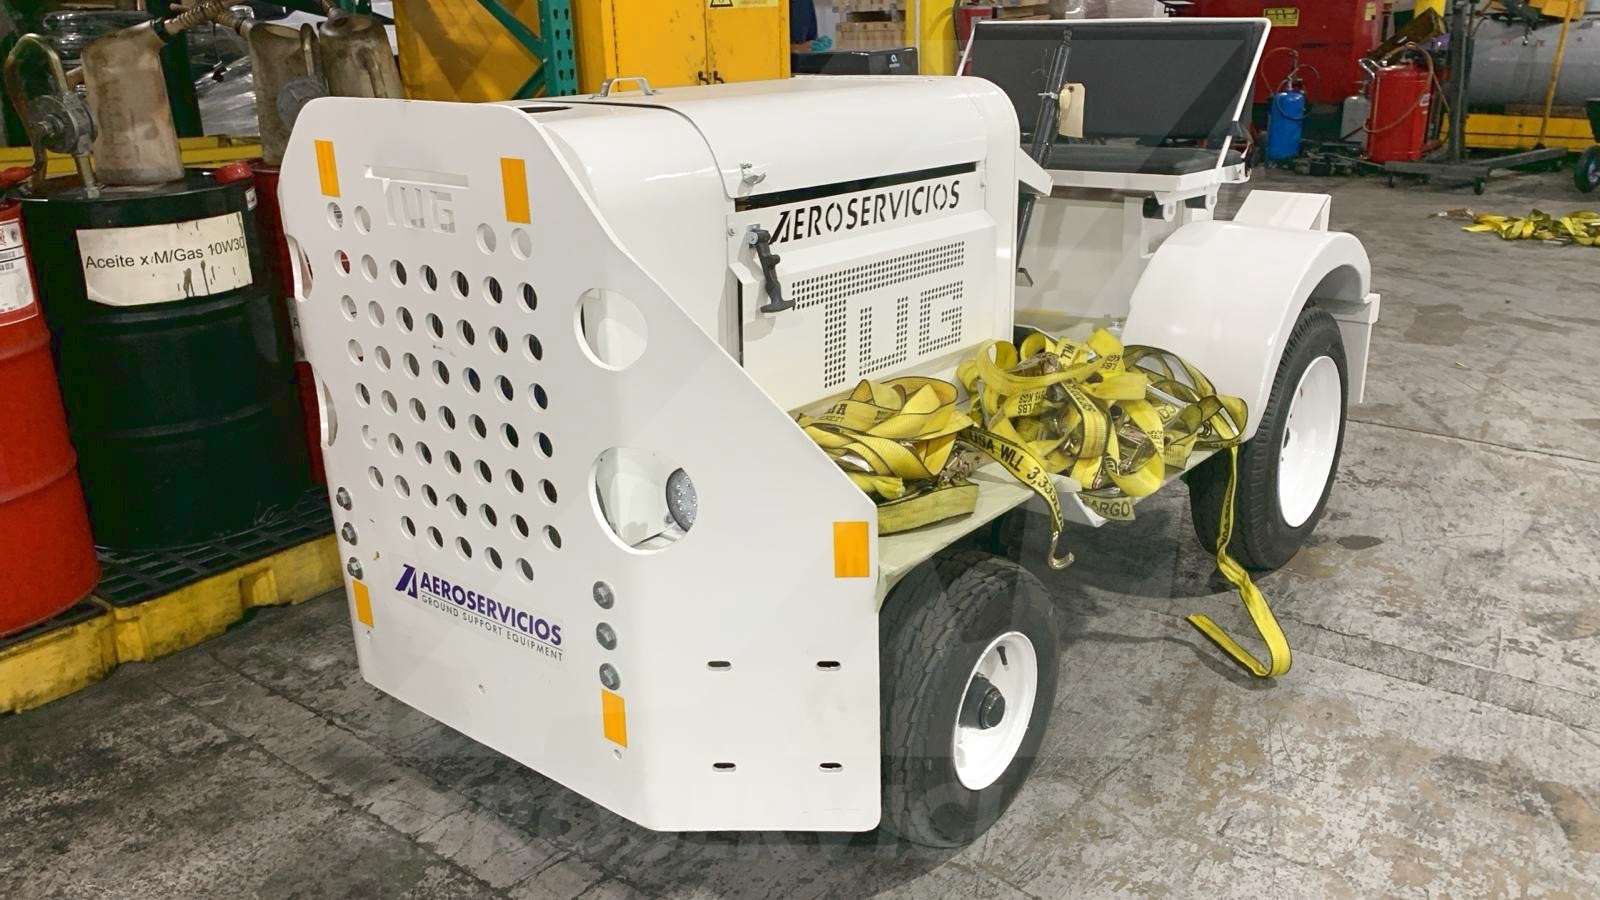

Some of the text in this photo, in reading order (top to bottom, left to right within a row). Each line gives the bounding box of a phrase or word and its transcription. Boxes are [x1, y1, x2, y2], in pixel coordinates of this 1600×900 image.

[363, 164, 469, 234] TUG
[769, 180, 961, 245] AEROSERVICIOS
[85, 253, 135, 269] Aceite
[140, 255, 150, 266] x
[153, 248, 204, 264] M/Gas
[791, 240, 965, 389] TUG
[1000, 444, 1025, 472] WLL
[420, 571, 562, 646] AEROSERVICIOS
[421, 594, 563, 662] GROUND SUPPORT EQUIPMENT
